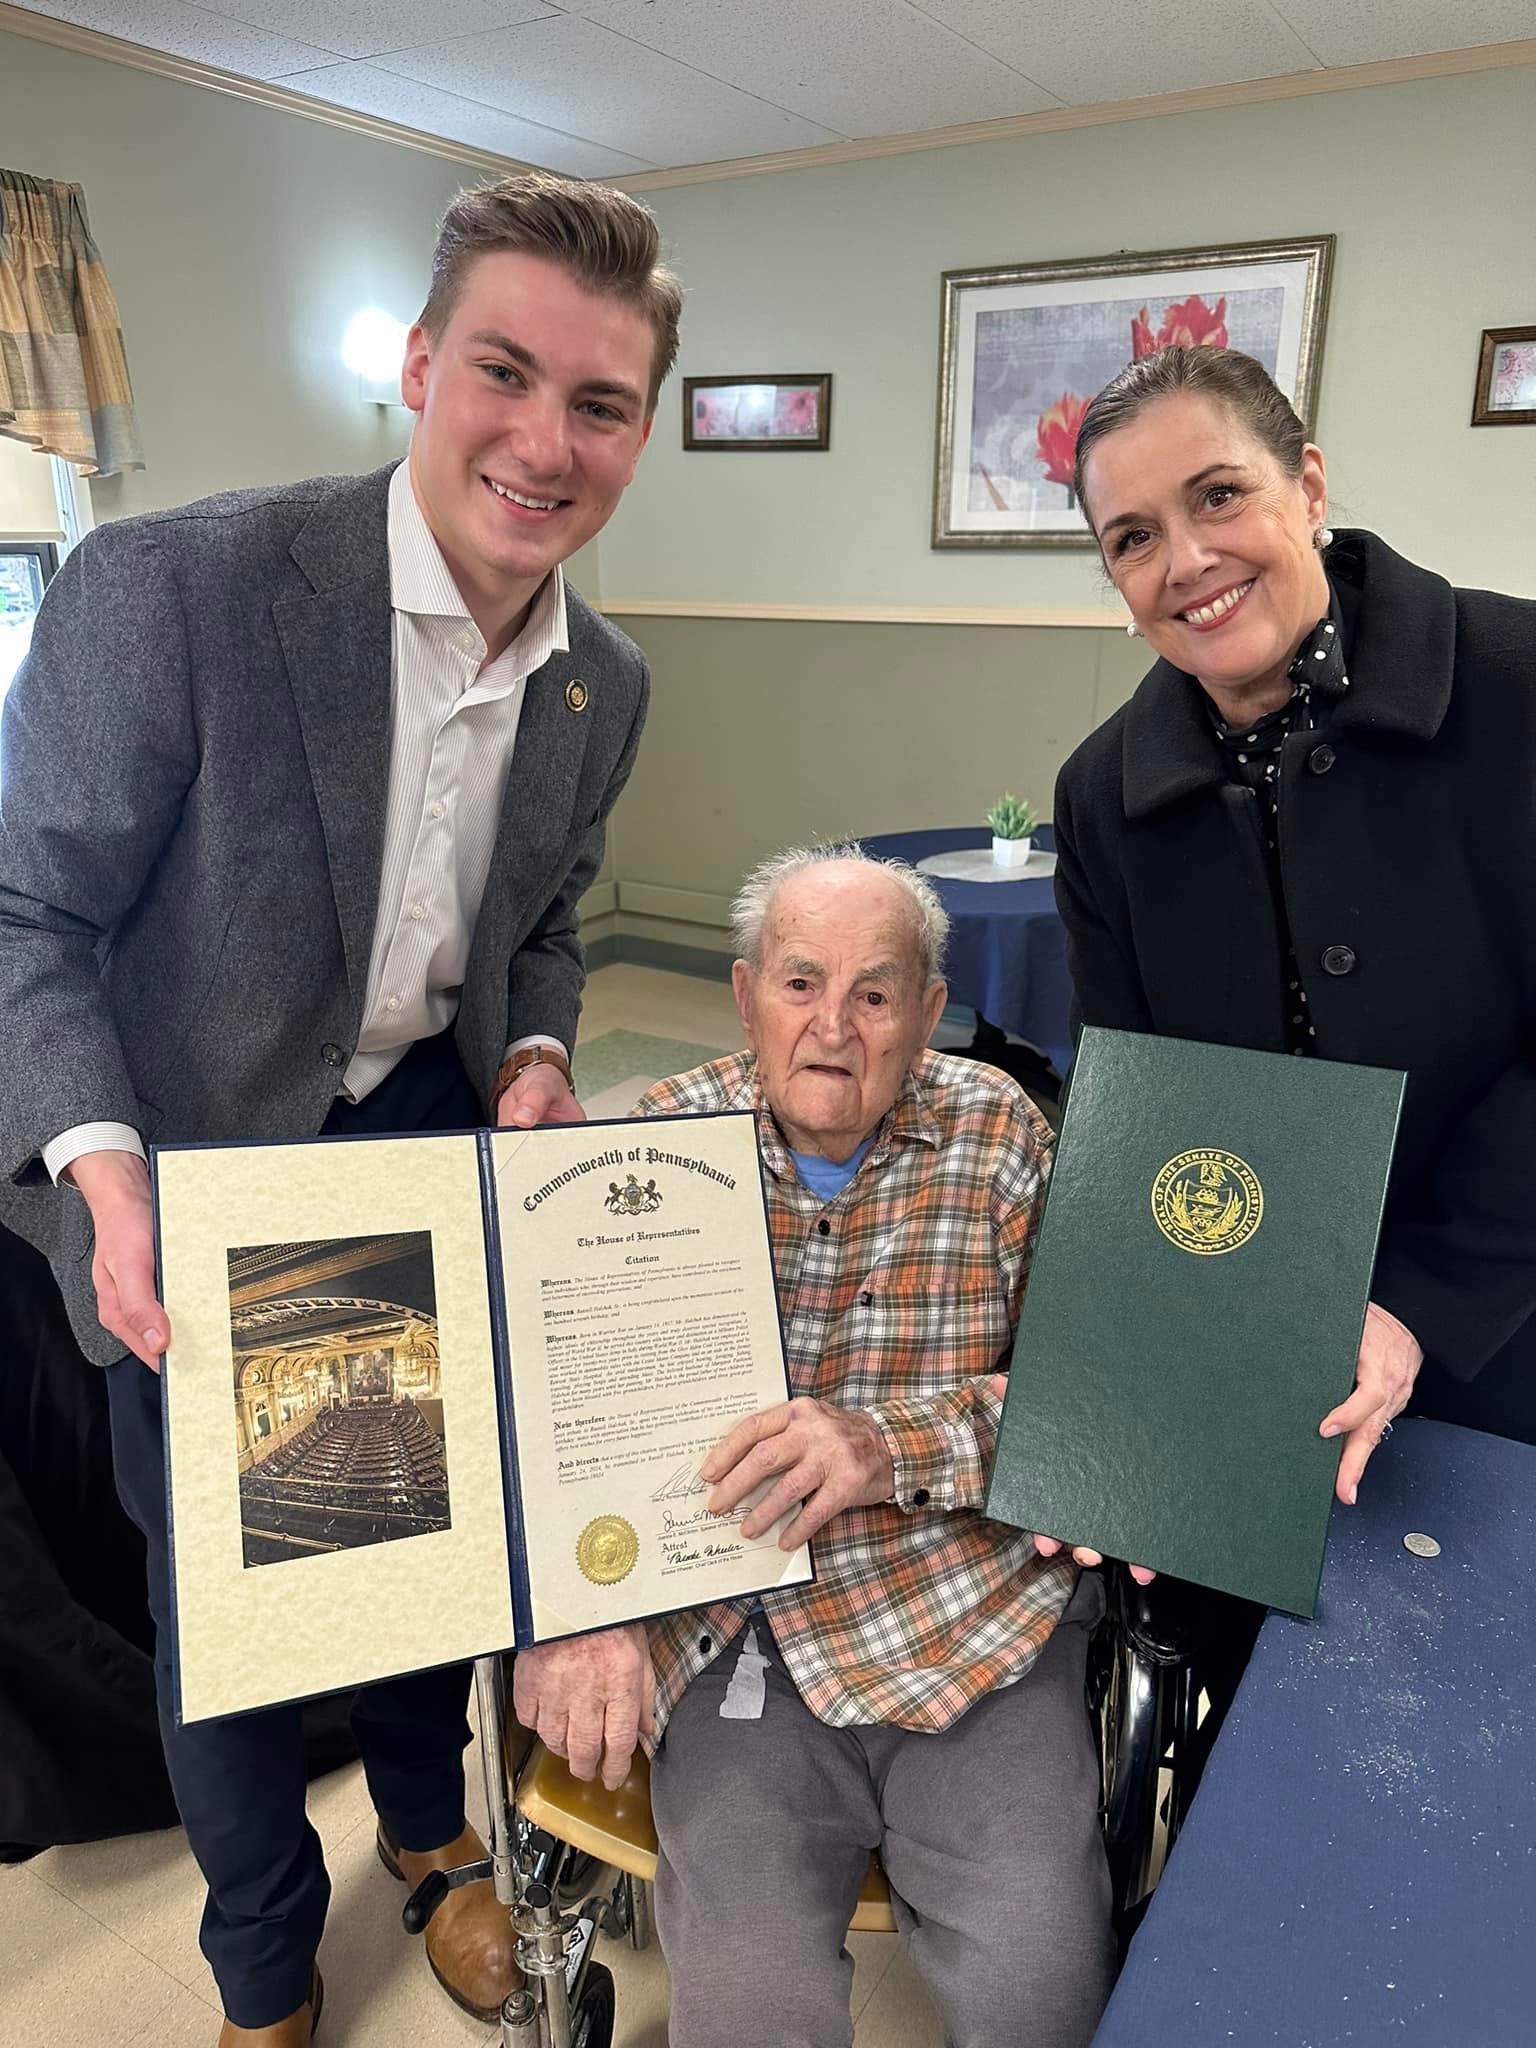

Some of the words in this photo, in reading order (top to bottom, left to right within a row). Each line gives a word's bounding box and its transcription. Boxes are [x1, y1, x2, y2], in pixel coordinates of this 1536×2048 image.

[1178, 1152, 1222, 1166] SENATE
[1225, 1158, 1241, 1169] OF
[523, 1149, 624, 1212] Commonwealth
[627, 1147, 641, 1162] of
[645, 1147, 737, 1191] Pennsylvania
[1160, 1164, 1178, 1184] THE
[1156, 1187, 1165, 1201] OF
[1226, 1169, 1260, 1245] PENNSYLVANIA
[1156, 1204, 1174, 1233] SEAL
[577, 1237, 594, 1249] The
[597, 1235, 624, 1246] House
[626, 1233, 635, 1243] of
[637, 1227, 701, 1243] Representatives
[625, 1254, 660, 1266] Citation
[557, 1461, 574, 1471] And
[661, 1541, 688, 1554] Attest
